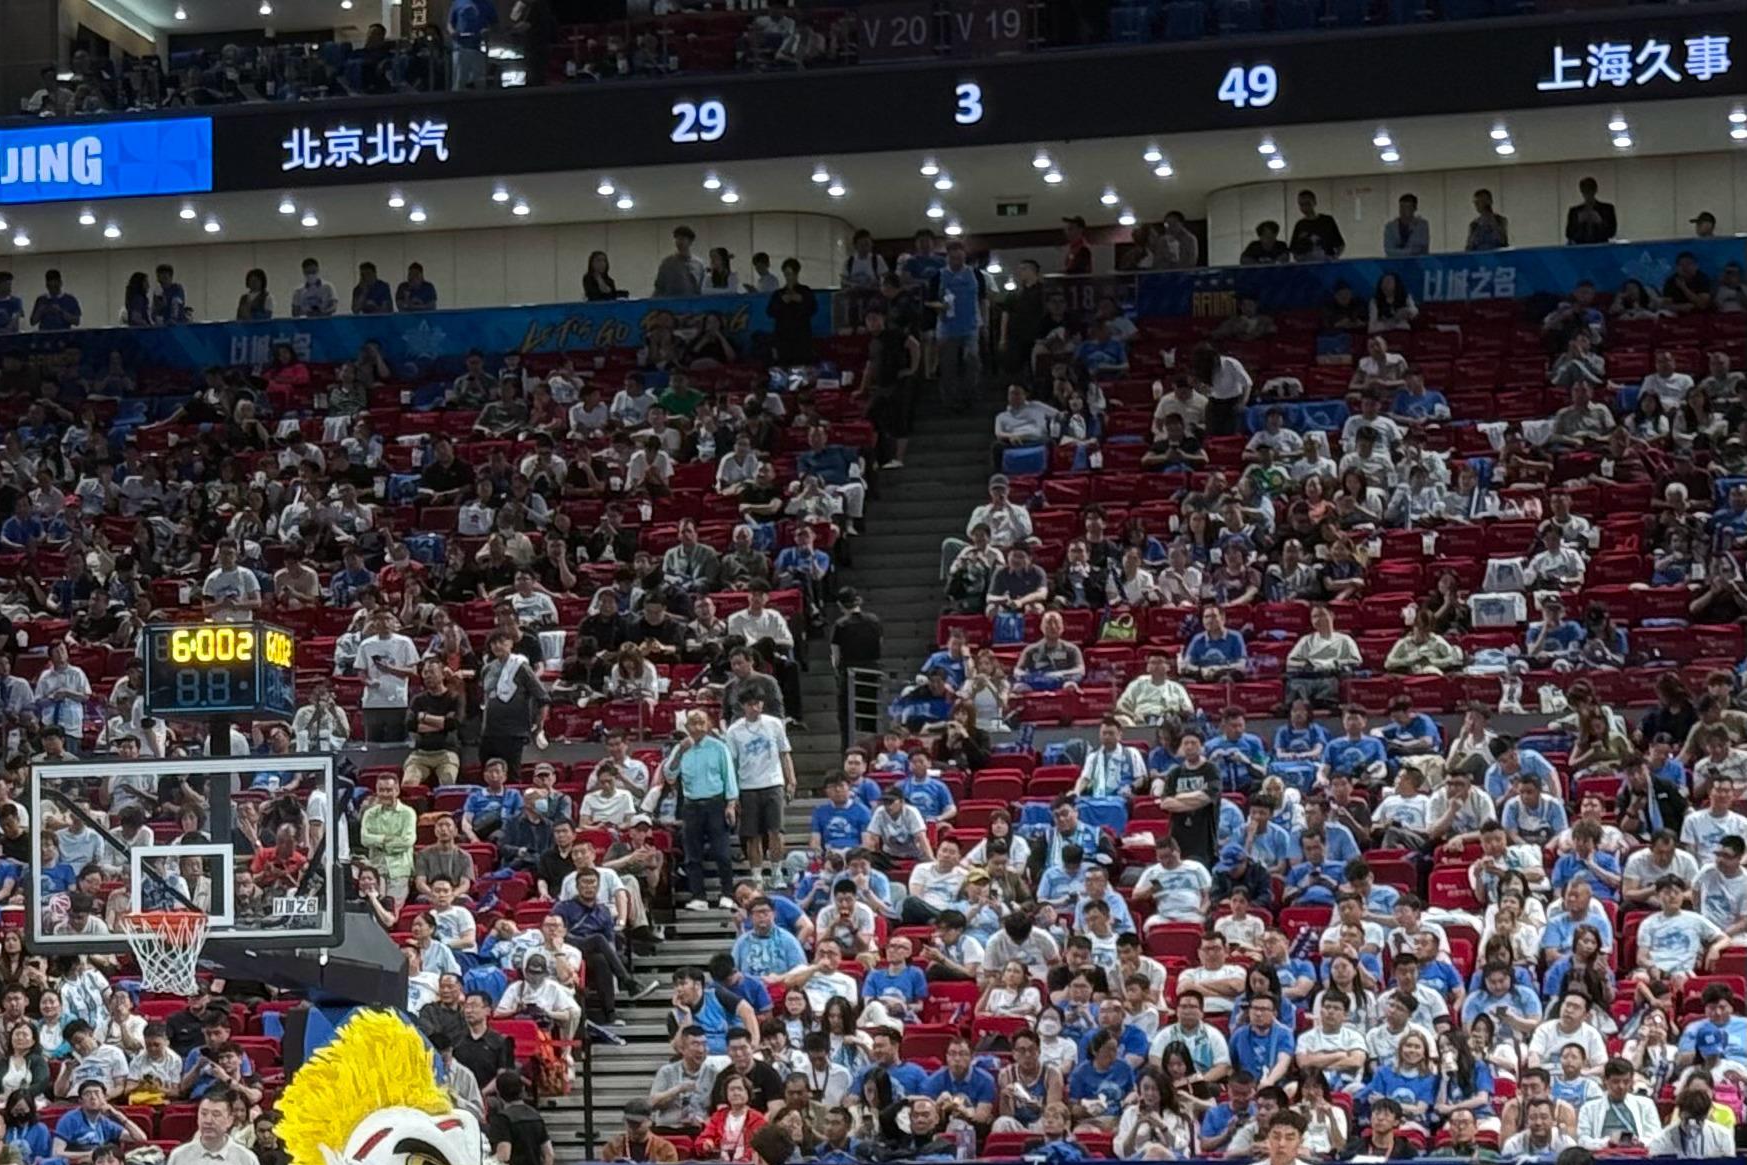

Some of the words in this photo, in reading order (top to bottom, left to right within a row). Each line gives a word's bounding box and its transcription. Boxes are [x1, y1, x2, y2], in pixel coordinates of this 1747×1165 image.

[861, 18, 881, 49] V
[890, 15, 928, 47] 20
[954, 11, 974, 42] V
[985, 8, 1021, 40] 19
[1536, 35, 1733, 93] 上海久事
[954, 83, 984, 125] 3
[1217, 65, 1278, 108] 49
[670, 100, 727, 143] 29
[281, 118, 450, 173] 北京北汽
